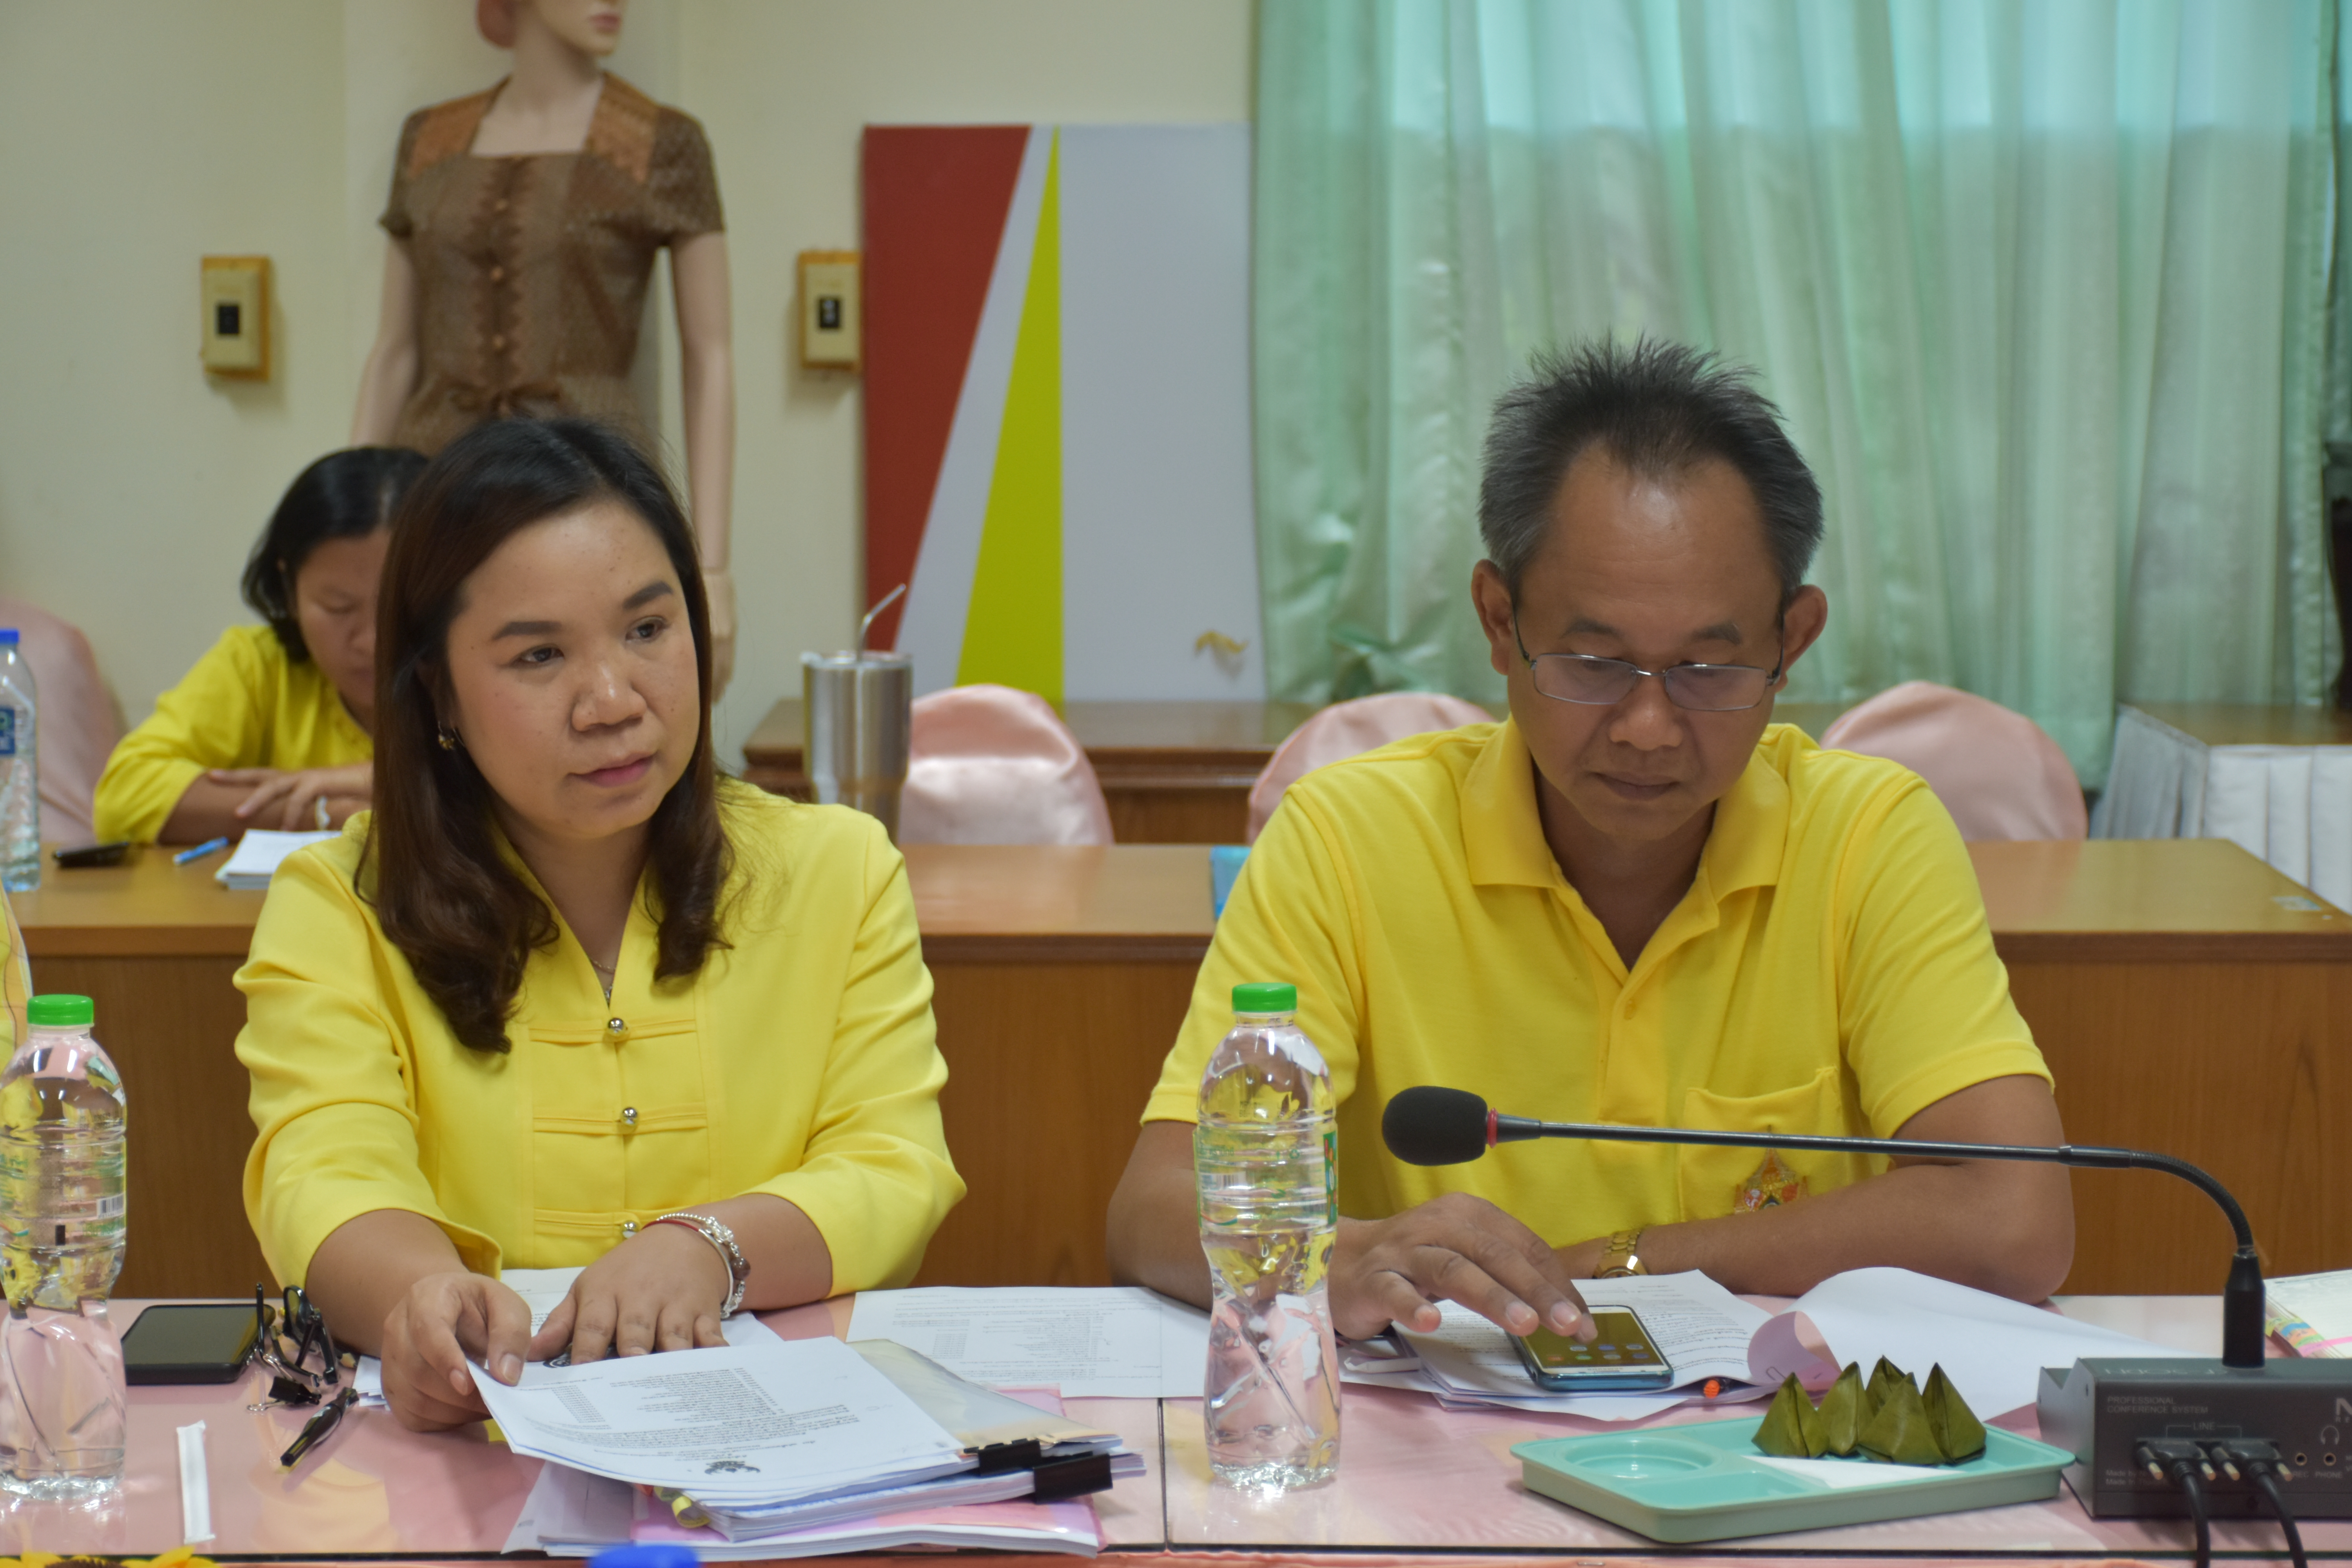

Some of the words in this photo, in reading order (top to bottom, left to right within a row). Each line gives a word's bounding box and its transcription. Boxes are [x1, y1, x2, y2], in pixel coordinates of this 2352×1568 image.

[2107, 1396, 2175, 1405] PROFESSIONAL
[2107, 1405, 2169, 1414] CONFERENCE
[2172, 1405, 2208, 1414] SYSTEM
